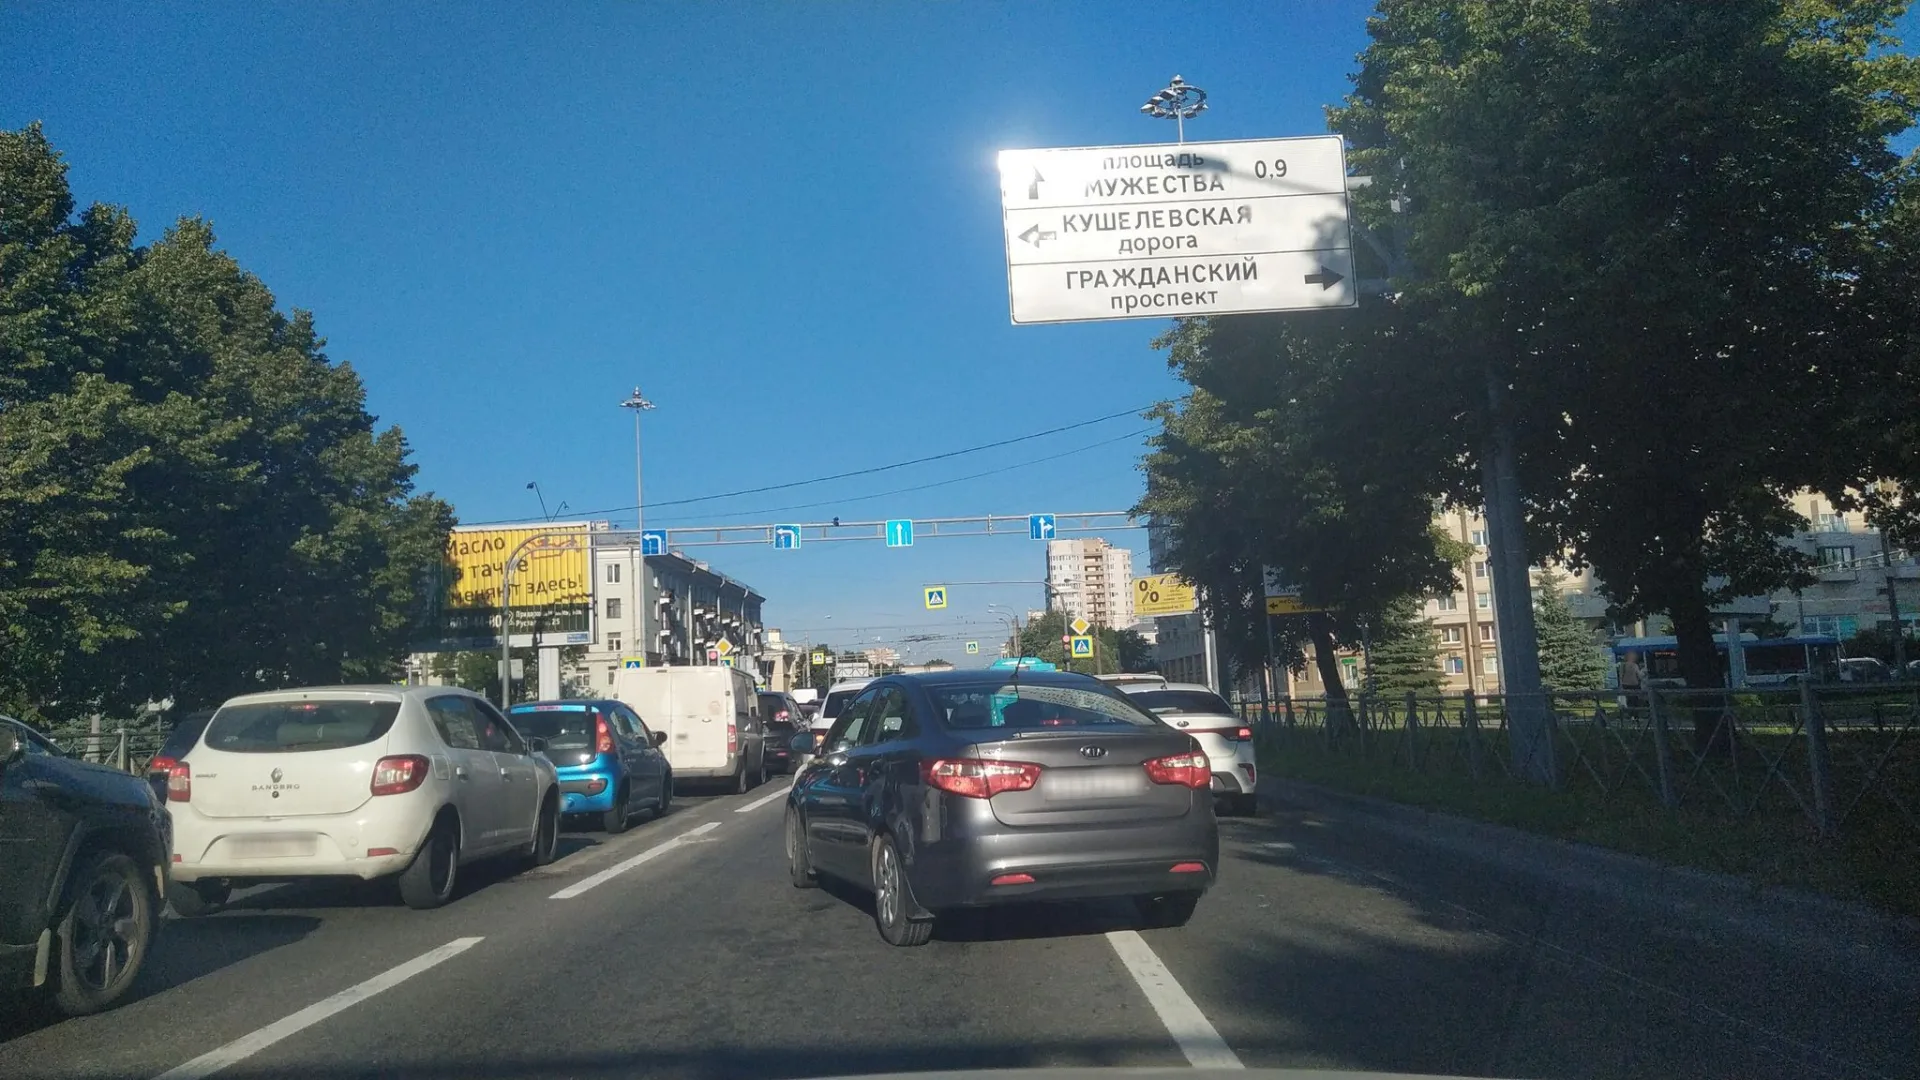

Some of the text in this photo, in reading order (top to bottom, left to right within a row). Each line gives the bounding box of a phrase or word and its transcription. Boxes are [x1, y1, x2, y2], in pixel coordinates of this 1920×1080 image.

[1103, 153, 1205, 171] площадь
[1254, 158, 1288, 181] 0,9
[1084, 173, 1225, 198] МУЖЕСТВА
[1062, 205, 1252, 233] КУШЕЛЕВСКАЯ
[1119, 235, 1198, 255] дорога
[1066, 256, 1258, 290] ГРАЖДАНСКИЙ
[1111, 290, 1218, 314] проспект
[468, 559, 529, 579] таче
[527, 573, 583, 595] здесь!
